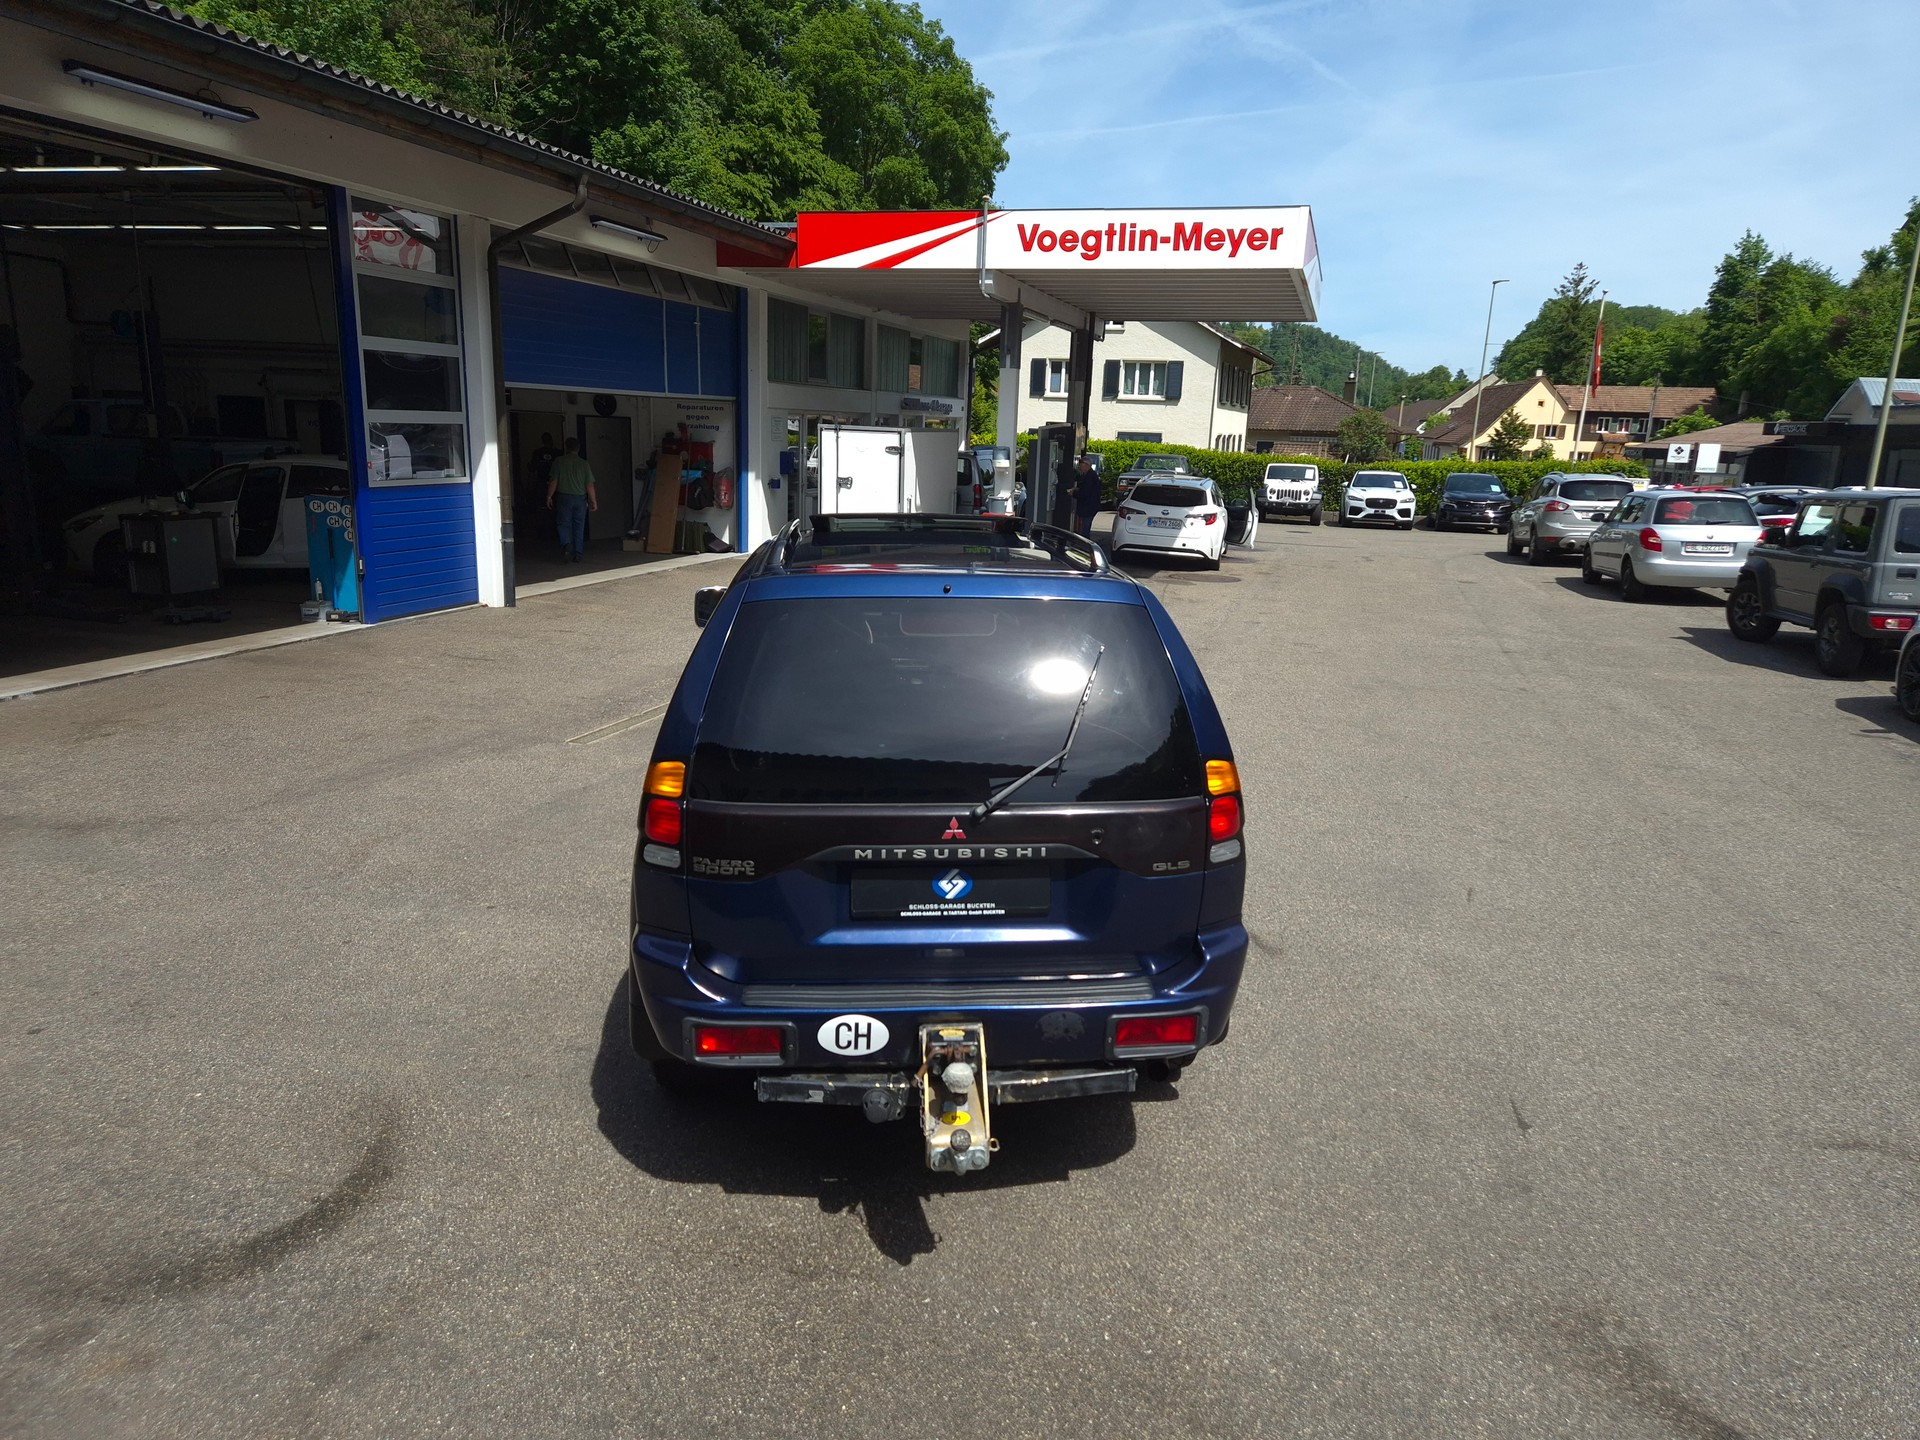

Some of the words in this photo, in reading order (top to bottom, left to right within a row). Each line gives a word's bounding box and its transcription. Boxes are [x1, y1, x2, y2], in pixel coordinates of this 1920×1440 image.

[1017, 222, 1284, 261] Voegtlin-Meyer
[676, 403, 724, 411] Reparaturen
[687, 423, 720, 431] rzahlung
[312, 501, 322, 511] CH
[328, 501, 338, 511] CH
[329, 517, 340, 526] CH
[854, 847, 1046, 859] MITSUBISHI
[693, 856, 755, 868] PAJERO
[1152, 860, 1191, 871] GLS
[834, 1022, 872, 1050] CH
